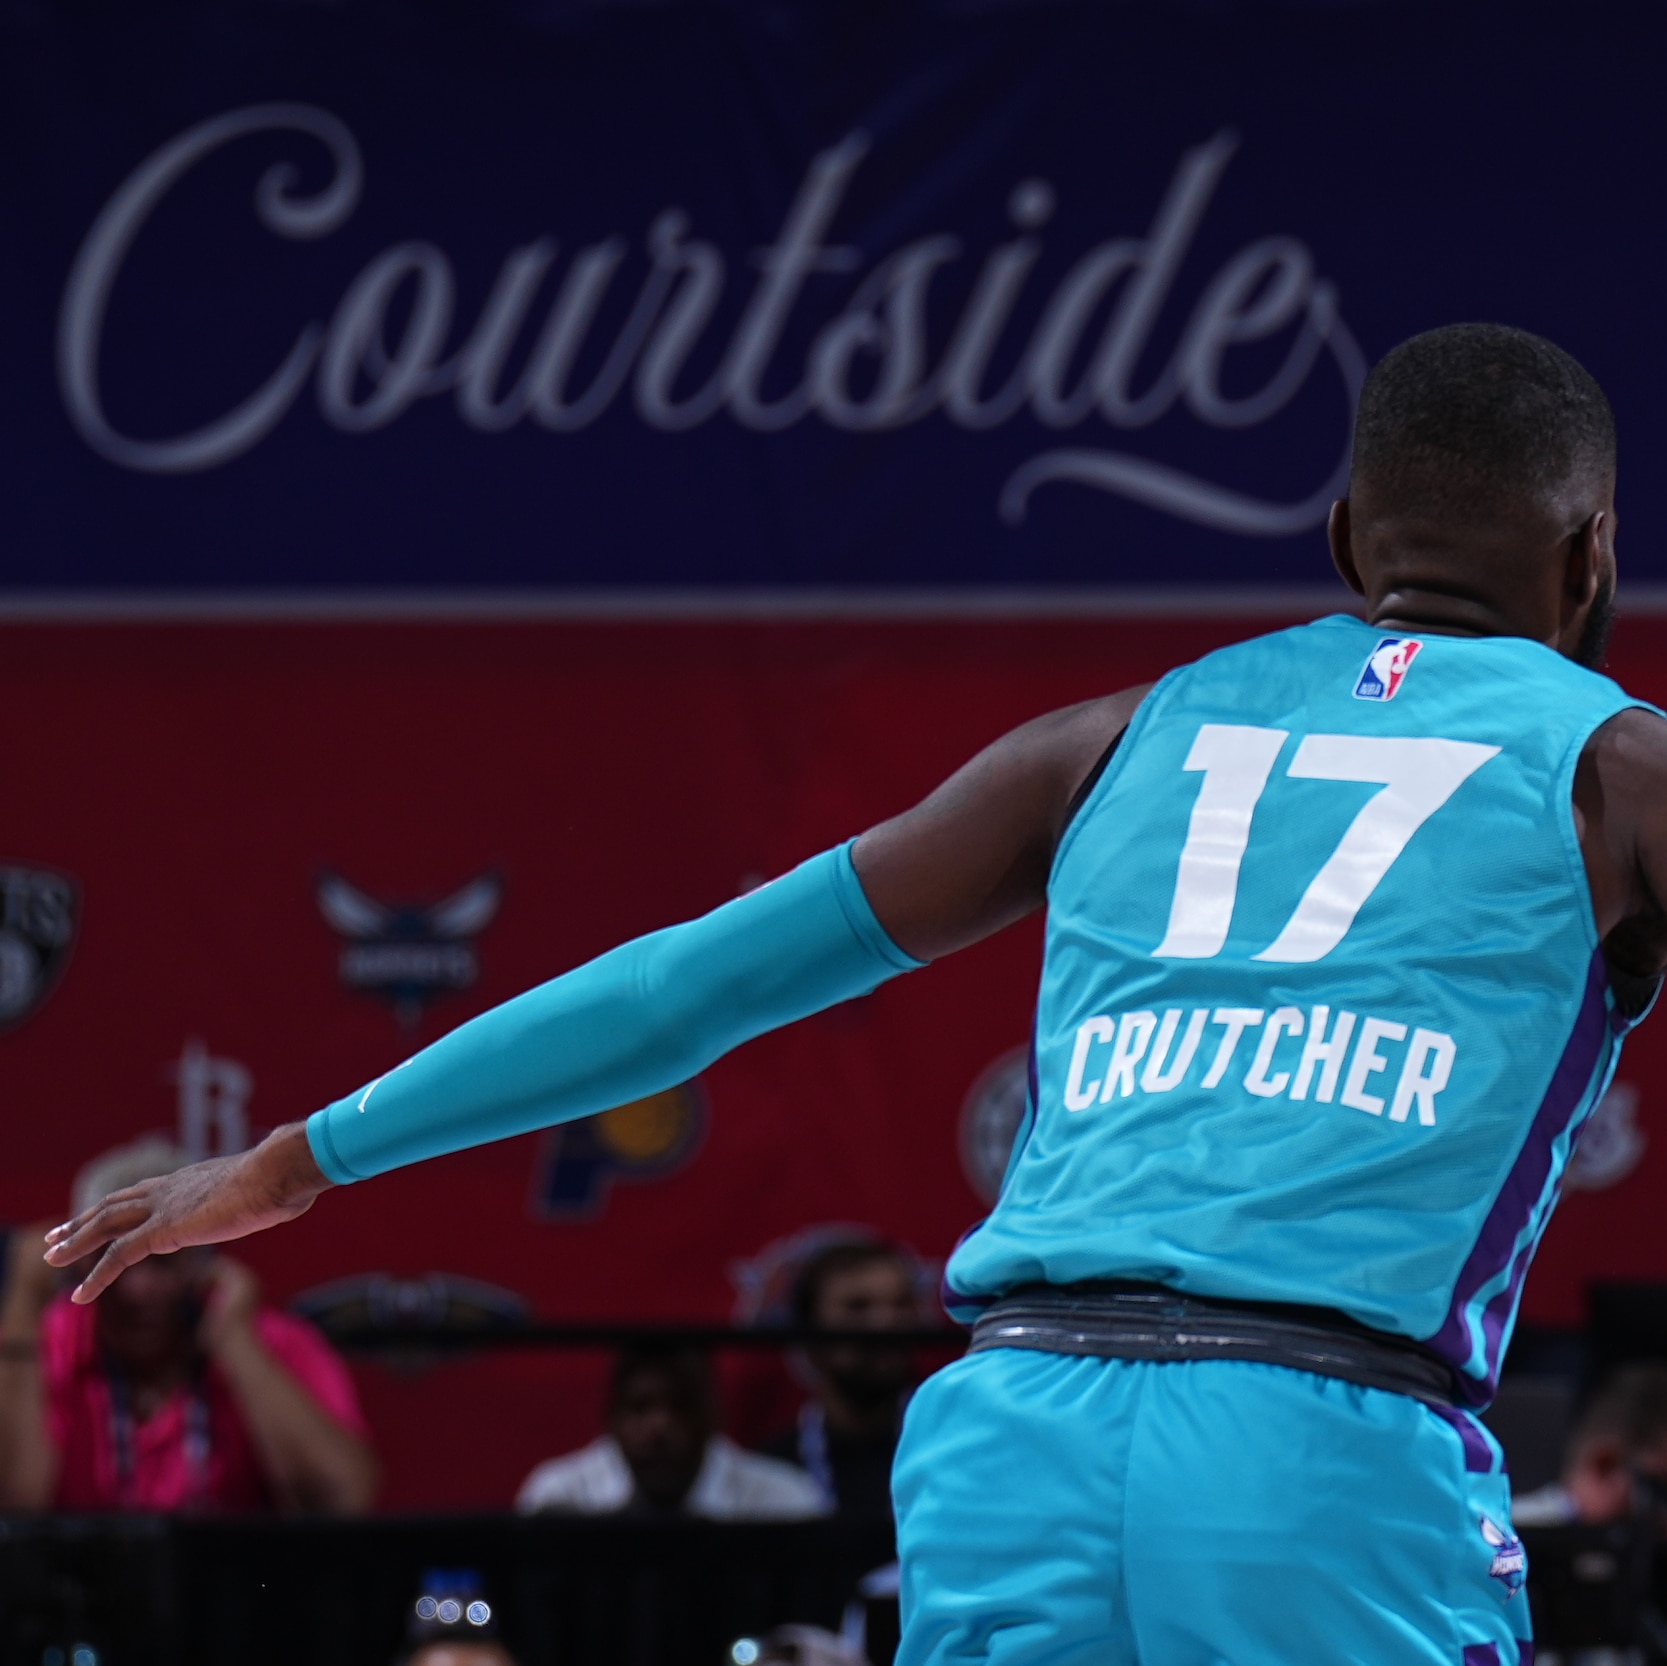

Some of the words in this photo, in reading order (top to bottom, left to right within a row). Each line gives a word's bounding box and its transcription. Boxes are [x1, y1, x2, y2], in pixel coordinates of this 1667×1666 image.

[57, 100, 1365, 536] Courtside
[1150, 723, 1503, 964] 17
[1064, 1005, 1457, 1127] CRUTCHER
